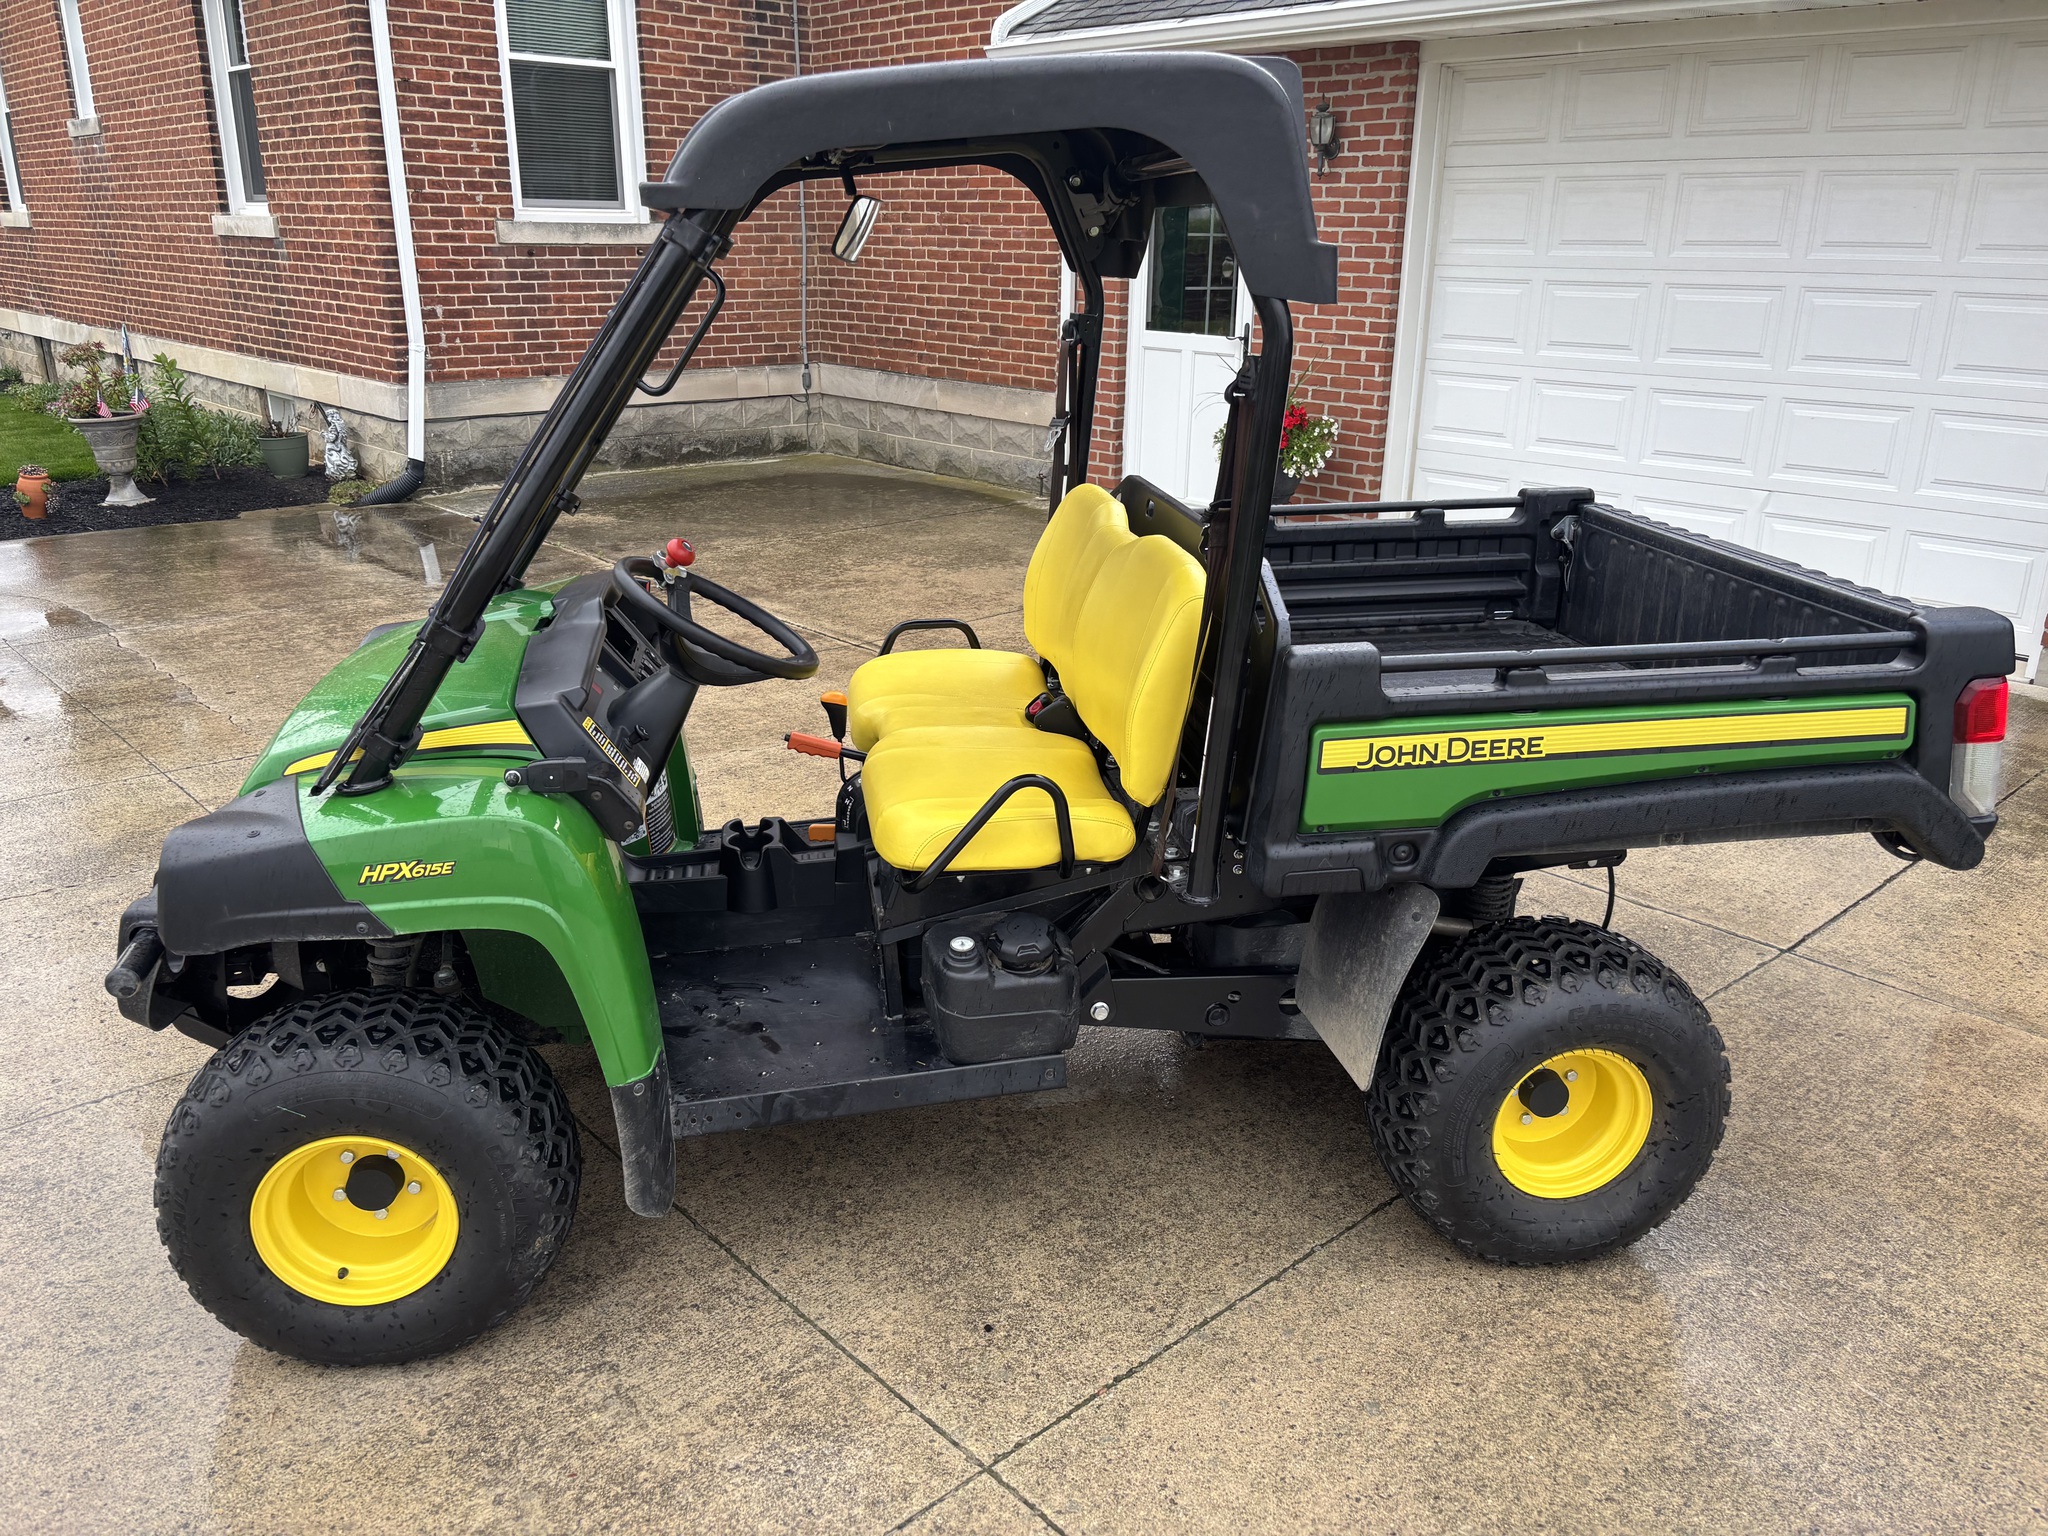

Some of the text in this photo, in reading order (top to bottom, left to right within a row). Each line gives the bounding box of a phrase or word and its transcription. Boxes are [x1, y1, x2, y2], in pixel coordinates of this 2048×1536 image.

[1356, 736, 1545, 767] JOHN DEERE
[358, 860, 456, 885] HPX615E
[1567, 1002, 1690, 1042] CARLISLE
